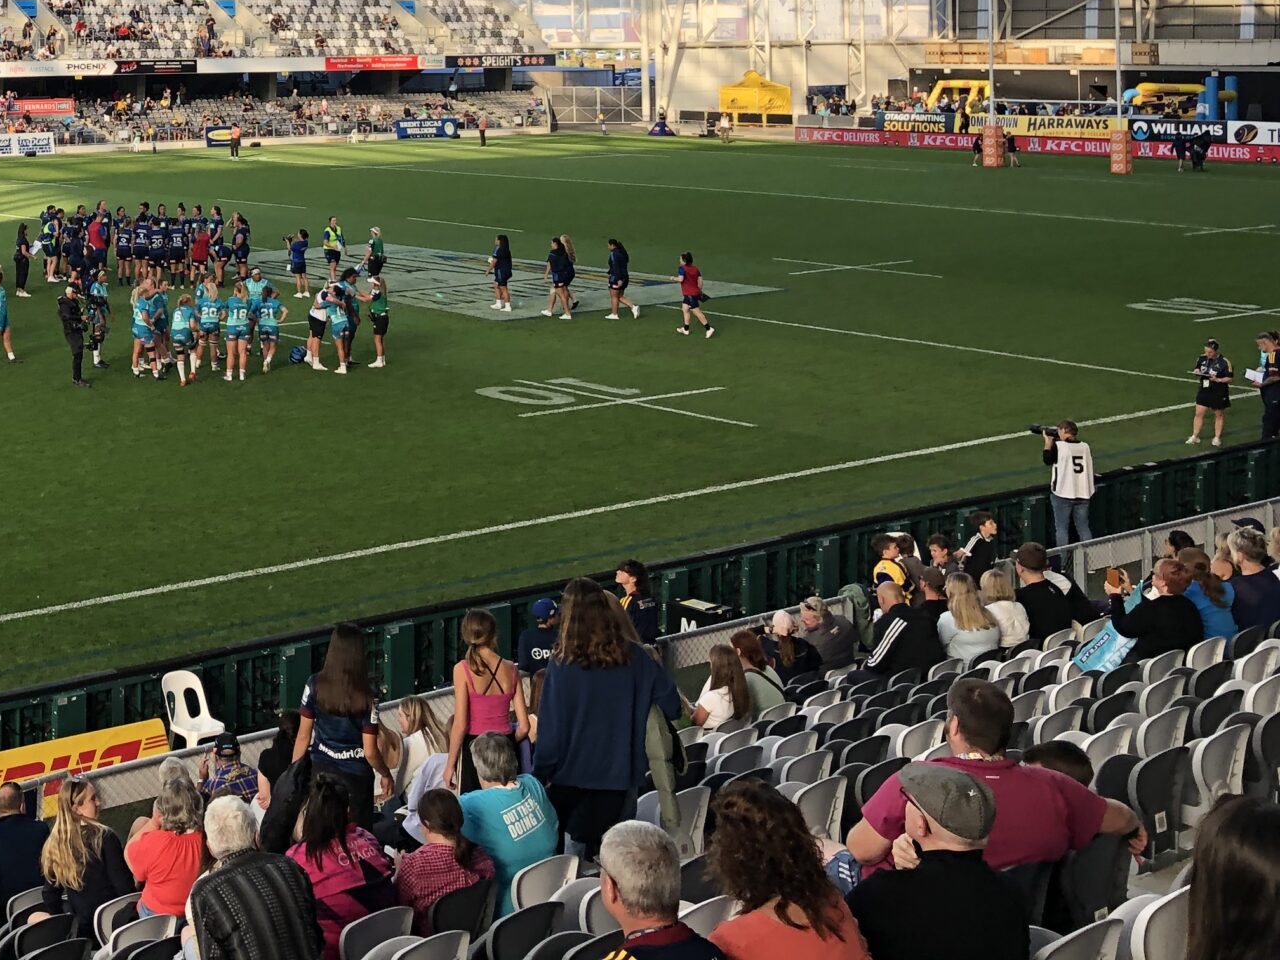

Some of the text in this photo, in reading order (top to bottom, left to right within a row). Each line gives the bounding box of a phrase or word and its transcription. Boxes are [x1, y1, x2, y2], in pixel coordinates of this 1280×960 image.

[482, 56, 522, 66] SPEIGHT'S
[67, 63, 108, 74] PHOENIX
[57, 102, 70, 111] HIRE
[910, 114, 946, 123] PAINTING
[1027, 117, 1109, 132] HARRAWAYS
[883, 121, 946, 132] SOLUTIONS
[1150, 123, 1224, 137] WILLIAMS
[810, 130, 880, 143] KFC DELIVERS
[923, 133, 956, 146] KFC
[1045, 139, 1083, 152] KFC
[1207, 146, 1250, 159] ELIVERS
[1072, 455, 1084, 474] 5
[502, 808, 519, 826] OUT
[507, 813, 538, 839] DOING
